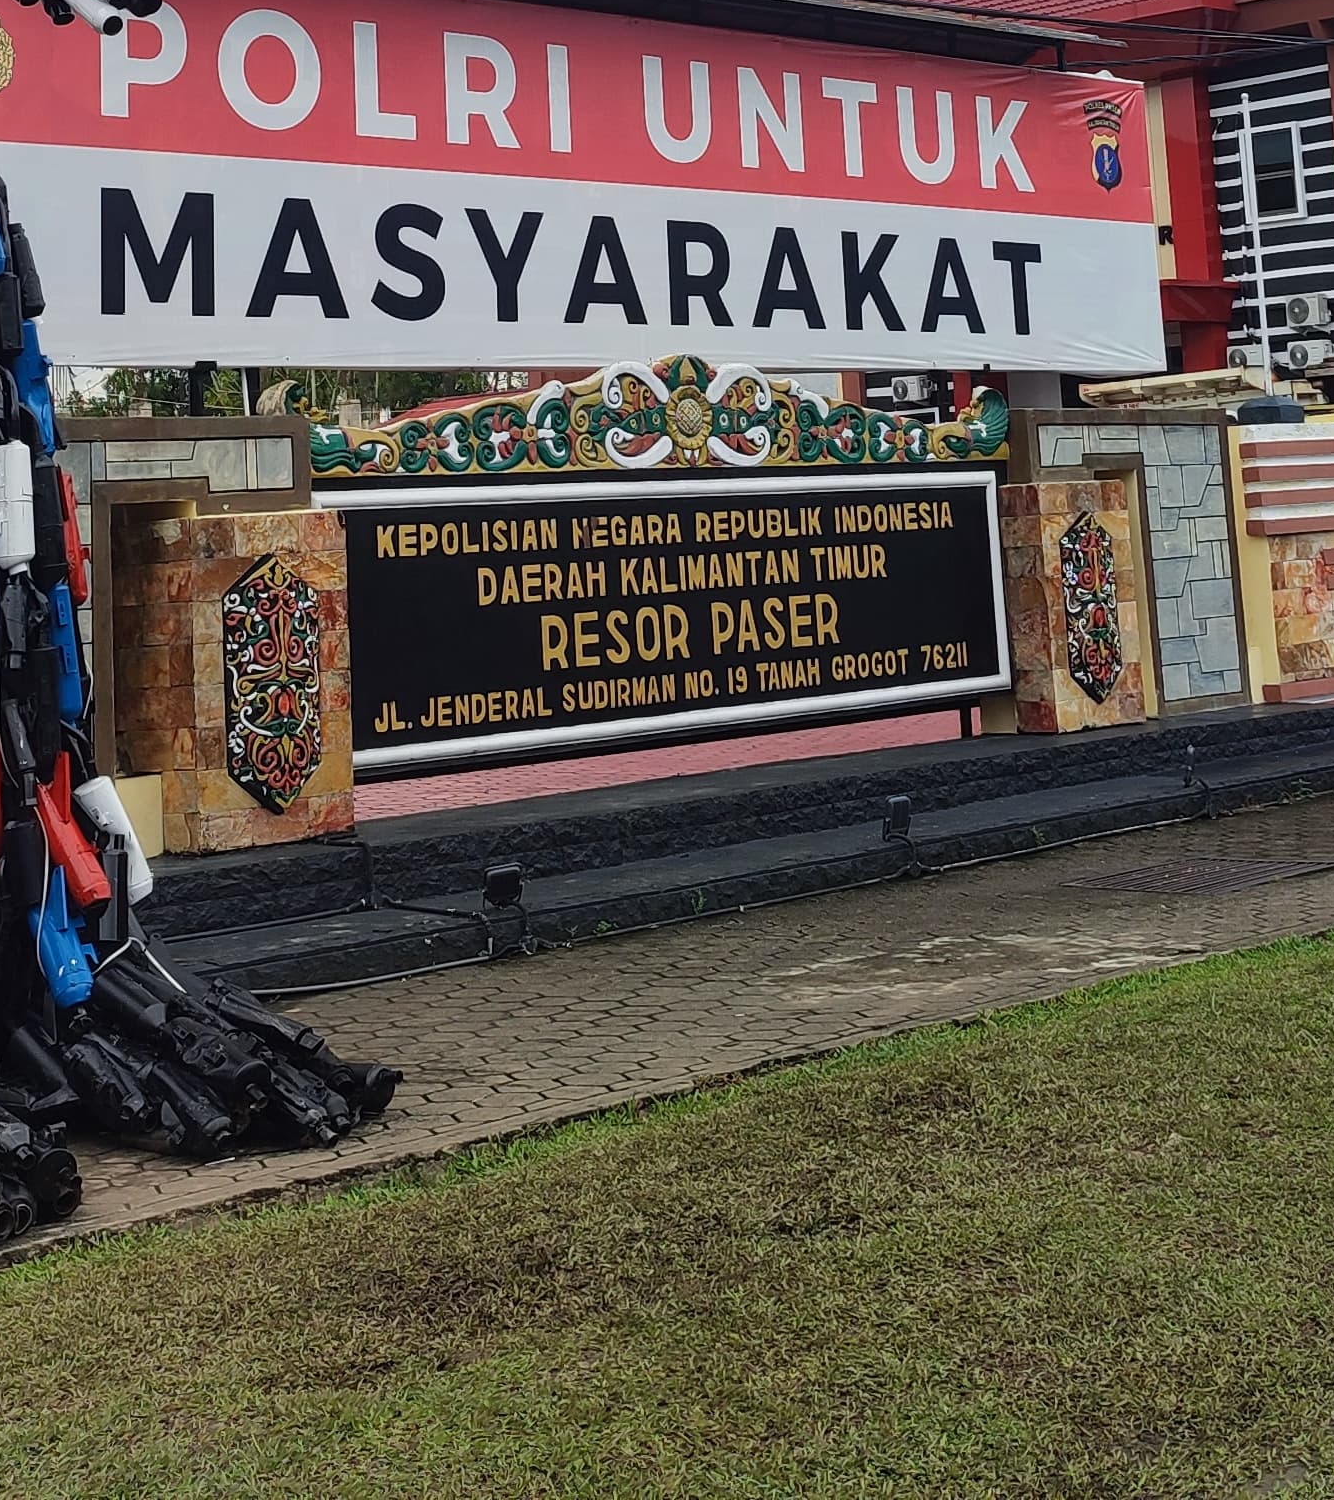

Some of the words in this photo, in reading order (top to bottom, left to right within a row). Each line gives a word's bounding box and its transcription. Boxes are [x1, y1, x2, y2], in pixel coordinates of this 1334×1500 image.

[100, 1, 572, 153] POLRI
[641, 54, 1035, 193] UNTUK
[100, 187, 1041, 335] MASYARAKAT
[376, 518, 557, 558] KEPOLISIAN
[572, 512, 682, 549] NEGARA
[695, 506, 823, 543] REPUBLIK
[834, 501, 953, 534] INDONESIA
[477, 560, 606, 606] DAERAH
[620, 548, 799, 597] KALIMANTAN
[810, 544, 887, 581] TIMUR
[540, 604, 690, 671] RESOR
[711, 593, 840, 655] PASER
[374, 701, 413, 733] JL.
[420, 686, 553, 728] JENDERAL
[562, 673, 675, 712] SUDIRMAN
[685, 669, 720, 699] NO.
[727, 666, 749, 694] 19
[756, 658, 820, 692] TANAH
[832, 648, 908, 682] GROGOT
[921, 641, 967, 671] 76211
